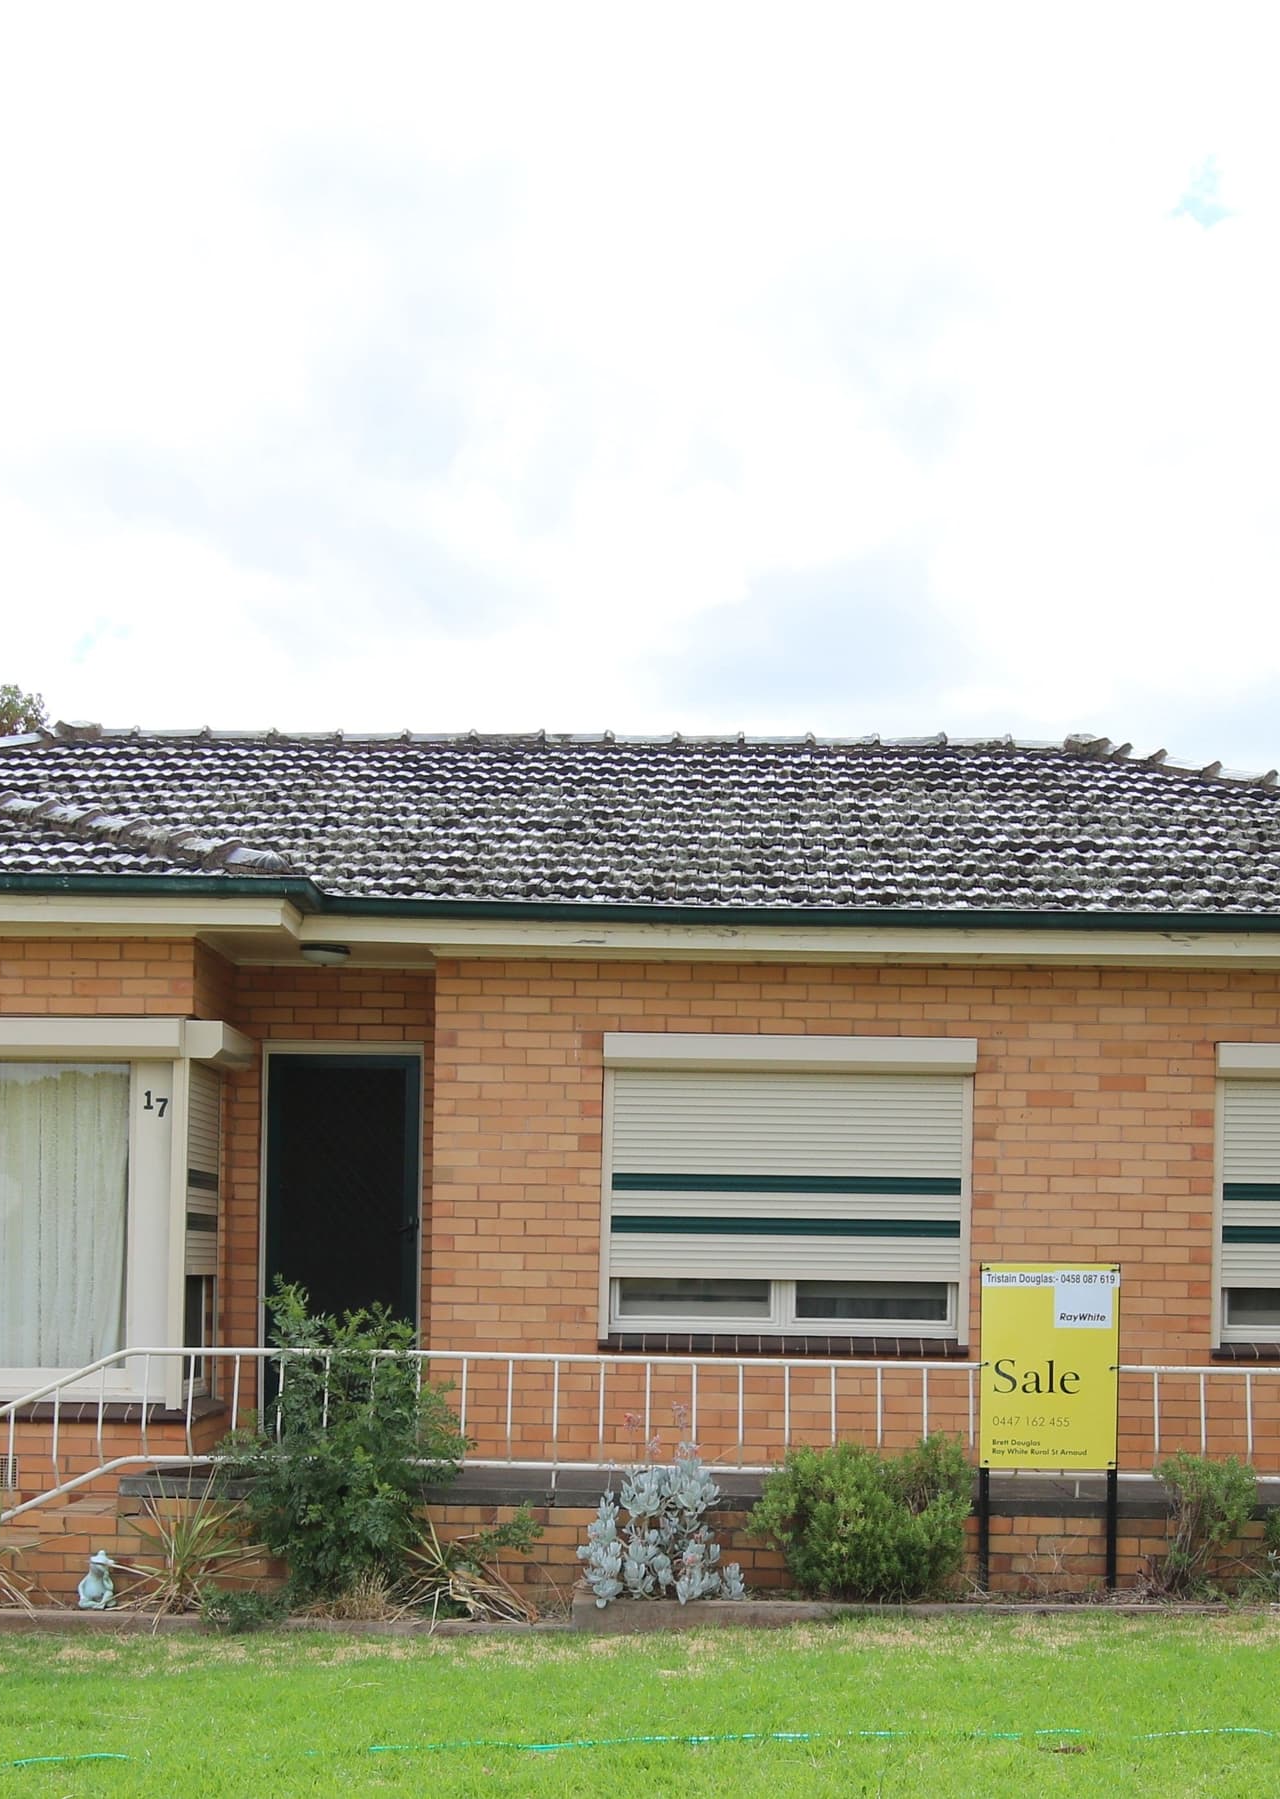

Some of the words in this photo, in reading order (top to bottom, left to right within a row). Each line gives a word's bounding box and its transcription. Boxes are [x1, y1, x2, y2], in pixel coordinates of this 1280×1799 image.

[144, 1090, 168, 1117] 17
[987, 1274, 1016, 1283] Tristain
[1061, 1274, 1080, 1284] 0458
[1083, 1275, 1097, 1284] 087
[1100, 1275, 1115, 1284] 619
[993, 1359, 1080, 1394] Sale
[992, 1416, 1021, 1427] 0447
[1026, 1416, 1045, 1427] 162
[1049, 1417, 1070, 1427] 455
[1011, 1439, 1041, 1447] Douglas
[992, 1448, 1005, 1456] Ray
[1030, 1448, 1049, 1456] Rural
